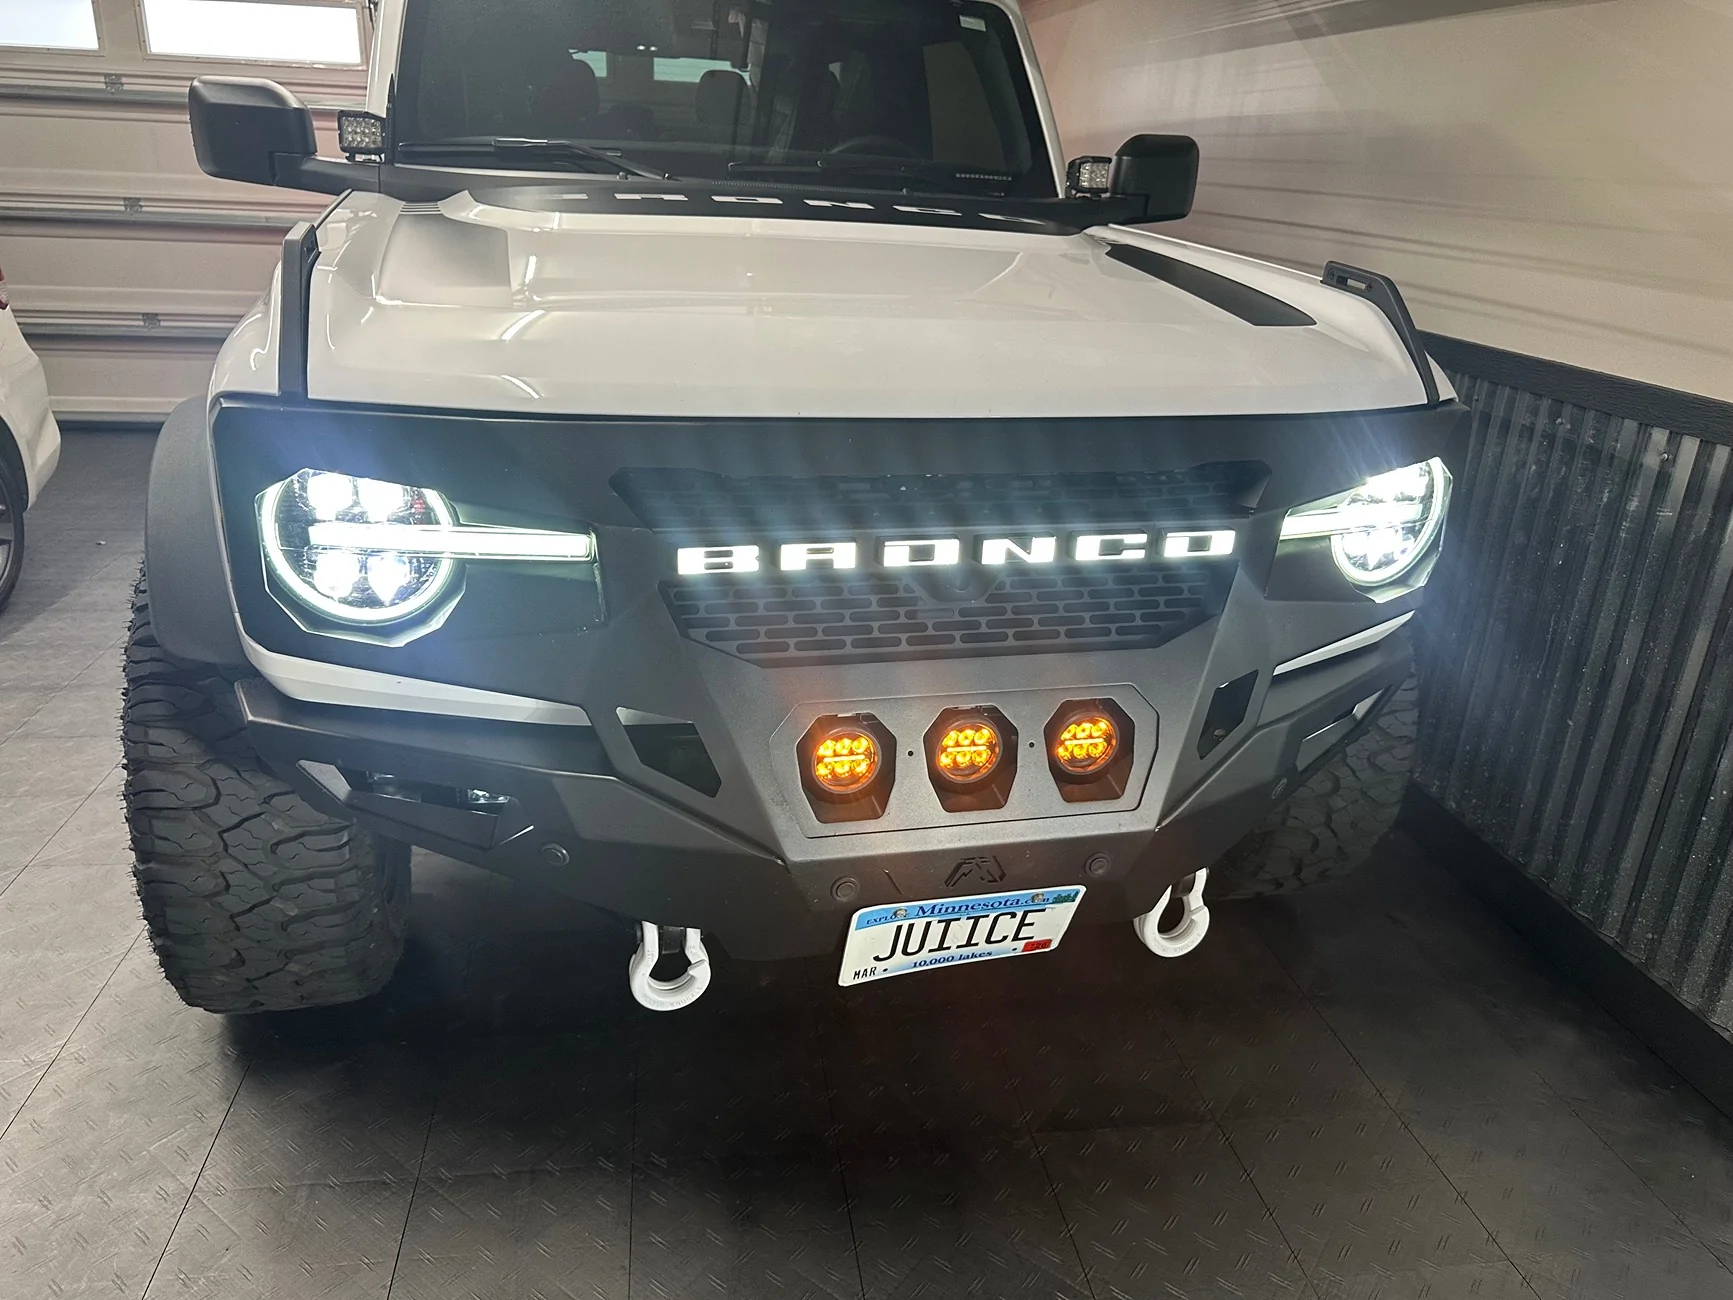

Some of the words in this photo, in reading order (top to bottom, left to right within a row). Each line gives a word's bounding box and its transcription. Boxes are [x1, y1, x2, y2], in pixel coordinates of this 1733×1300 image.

[677, 529, 1236, 575] BRONCO
[872, 907, 1047, 963] JUIICE
[958, 951, 993, 961] lakes
[853, 966, 877, 980] MAR
